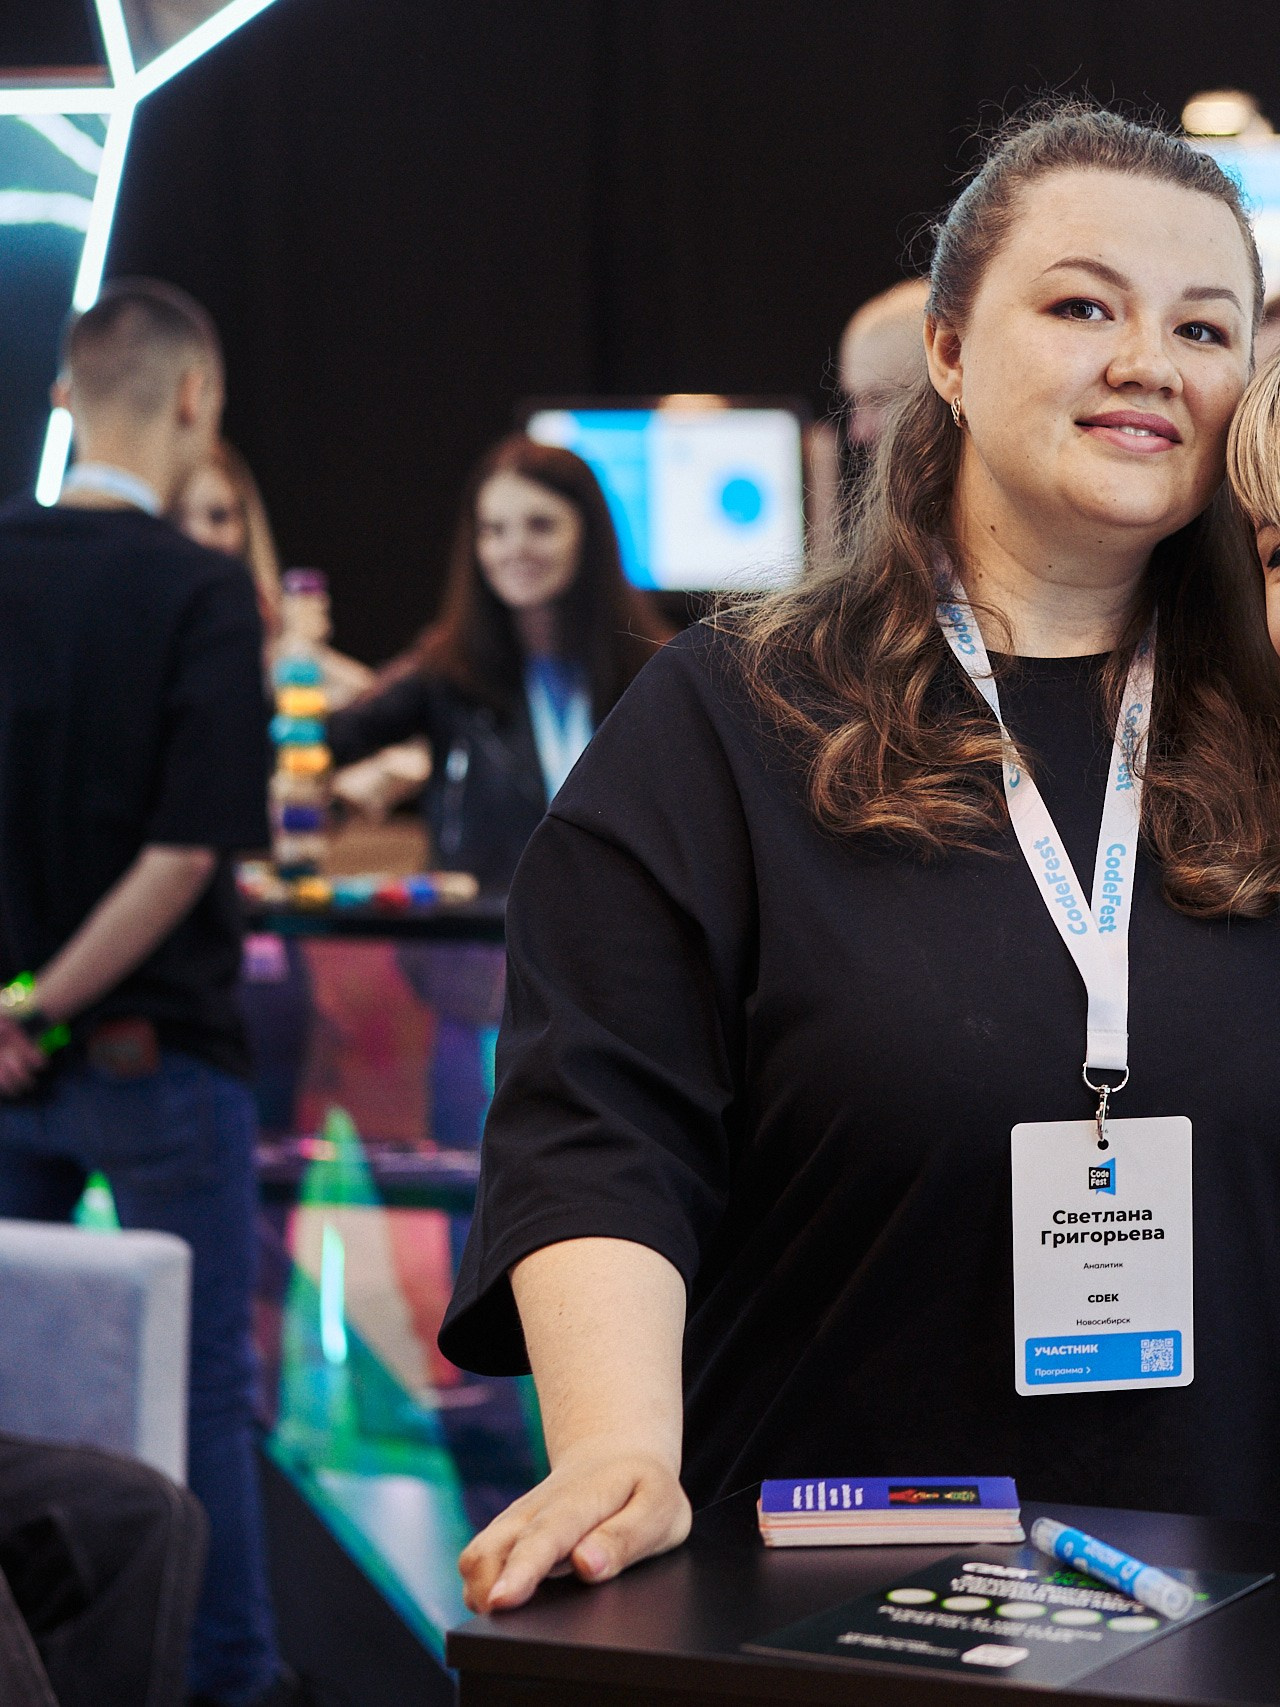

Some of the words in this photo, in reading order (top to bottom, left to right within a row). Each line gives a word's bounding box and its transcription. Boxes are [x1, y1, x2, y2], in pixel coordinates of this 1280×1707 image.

[1033, 836, 1088, 936] CodeFest
[1098, 843, 1127, 933] CodeFest
[1090, 1169, 1110, 1178] Code
[1090, 1178, 1107, 1187] Fest
[1052, 1209, 1153, 1225] Светлана
[1041, 1227, 1165, 1248] Григорьева
[1083, 1261, 1123, 1270] Аналитик
[1087, 1293, 1119, 1303] CDEK
[1076, 1316, 1131, 1326] Новосибирск
[1034, 1343, 1098, 1357] УЧАСТНИК
[1034, 1366, 1083, 1377] Программа
